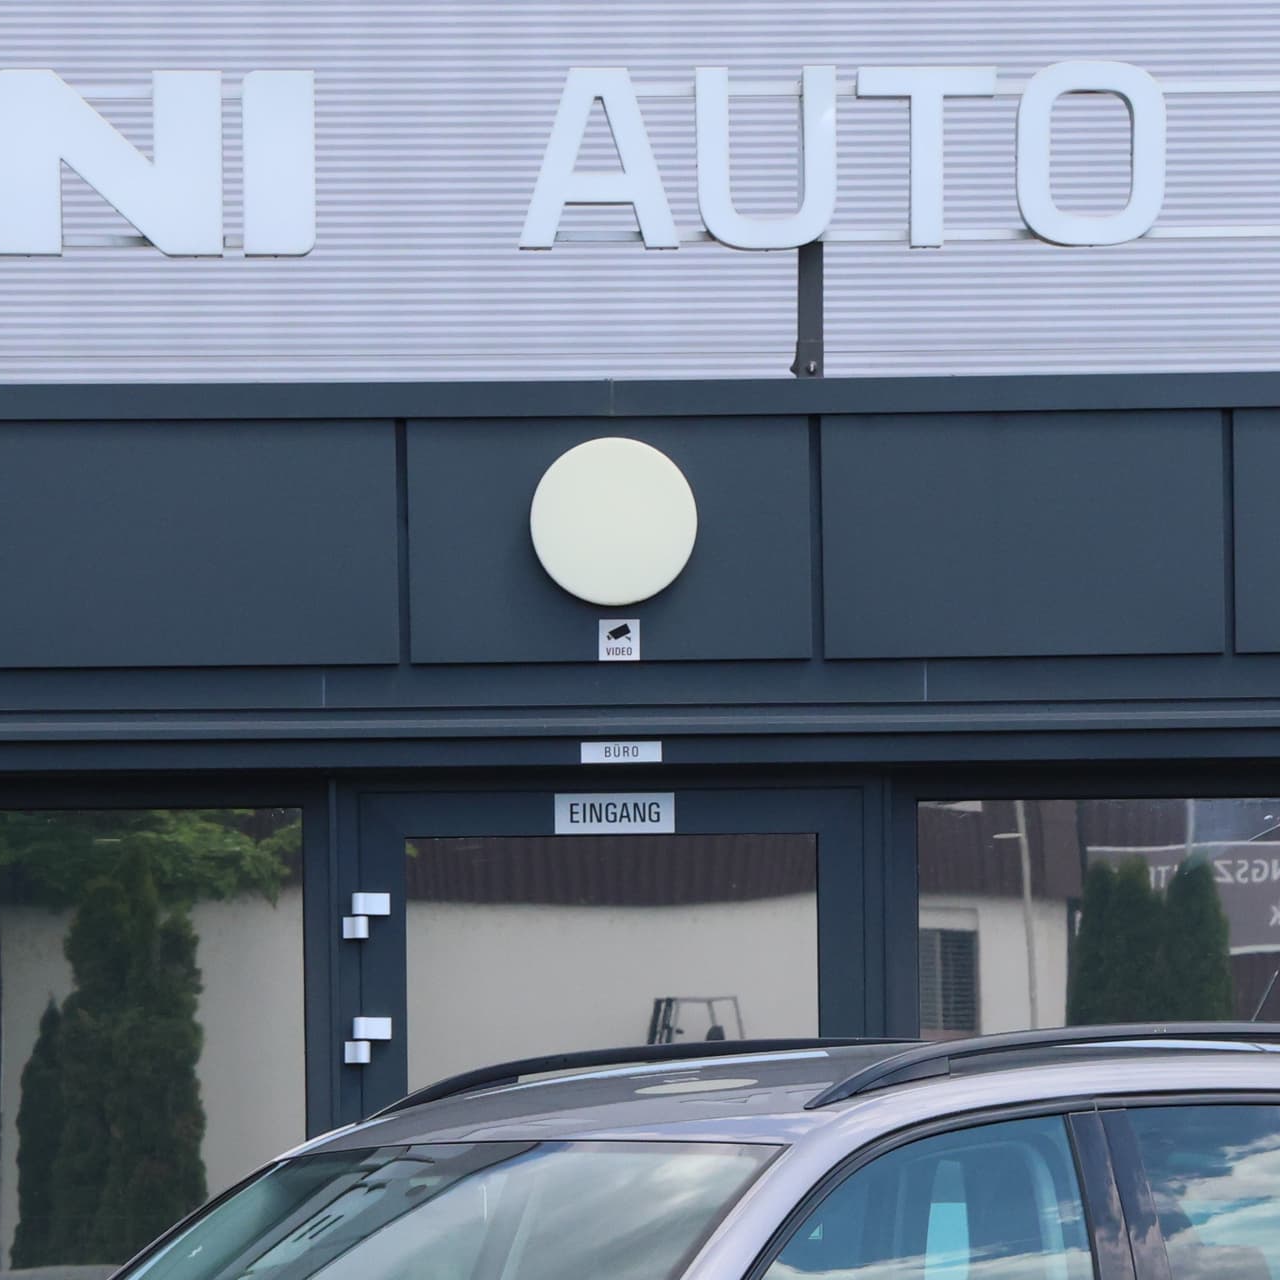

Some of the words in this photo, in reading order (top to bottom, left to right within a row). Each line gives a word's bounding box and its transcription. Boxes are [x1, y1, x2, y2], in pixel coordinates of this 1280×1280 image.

[518, 58, 1168, 250] AUTO
[606, 646, 633, 656] VIDEO
[604, 743, 640, 758] BÜRO
[569, 801, 661, 824] EINGANG
